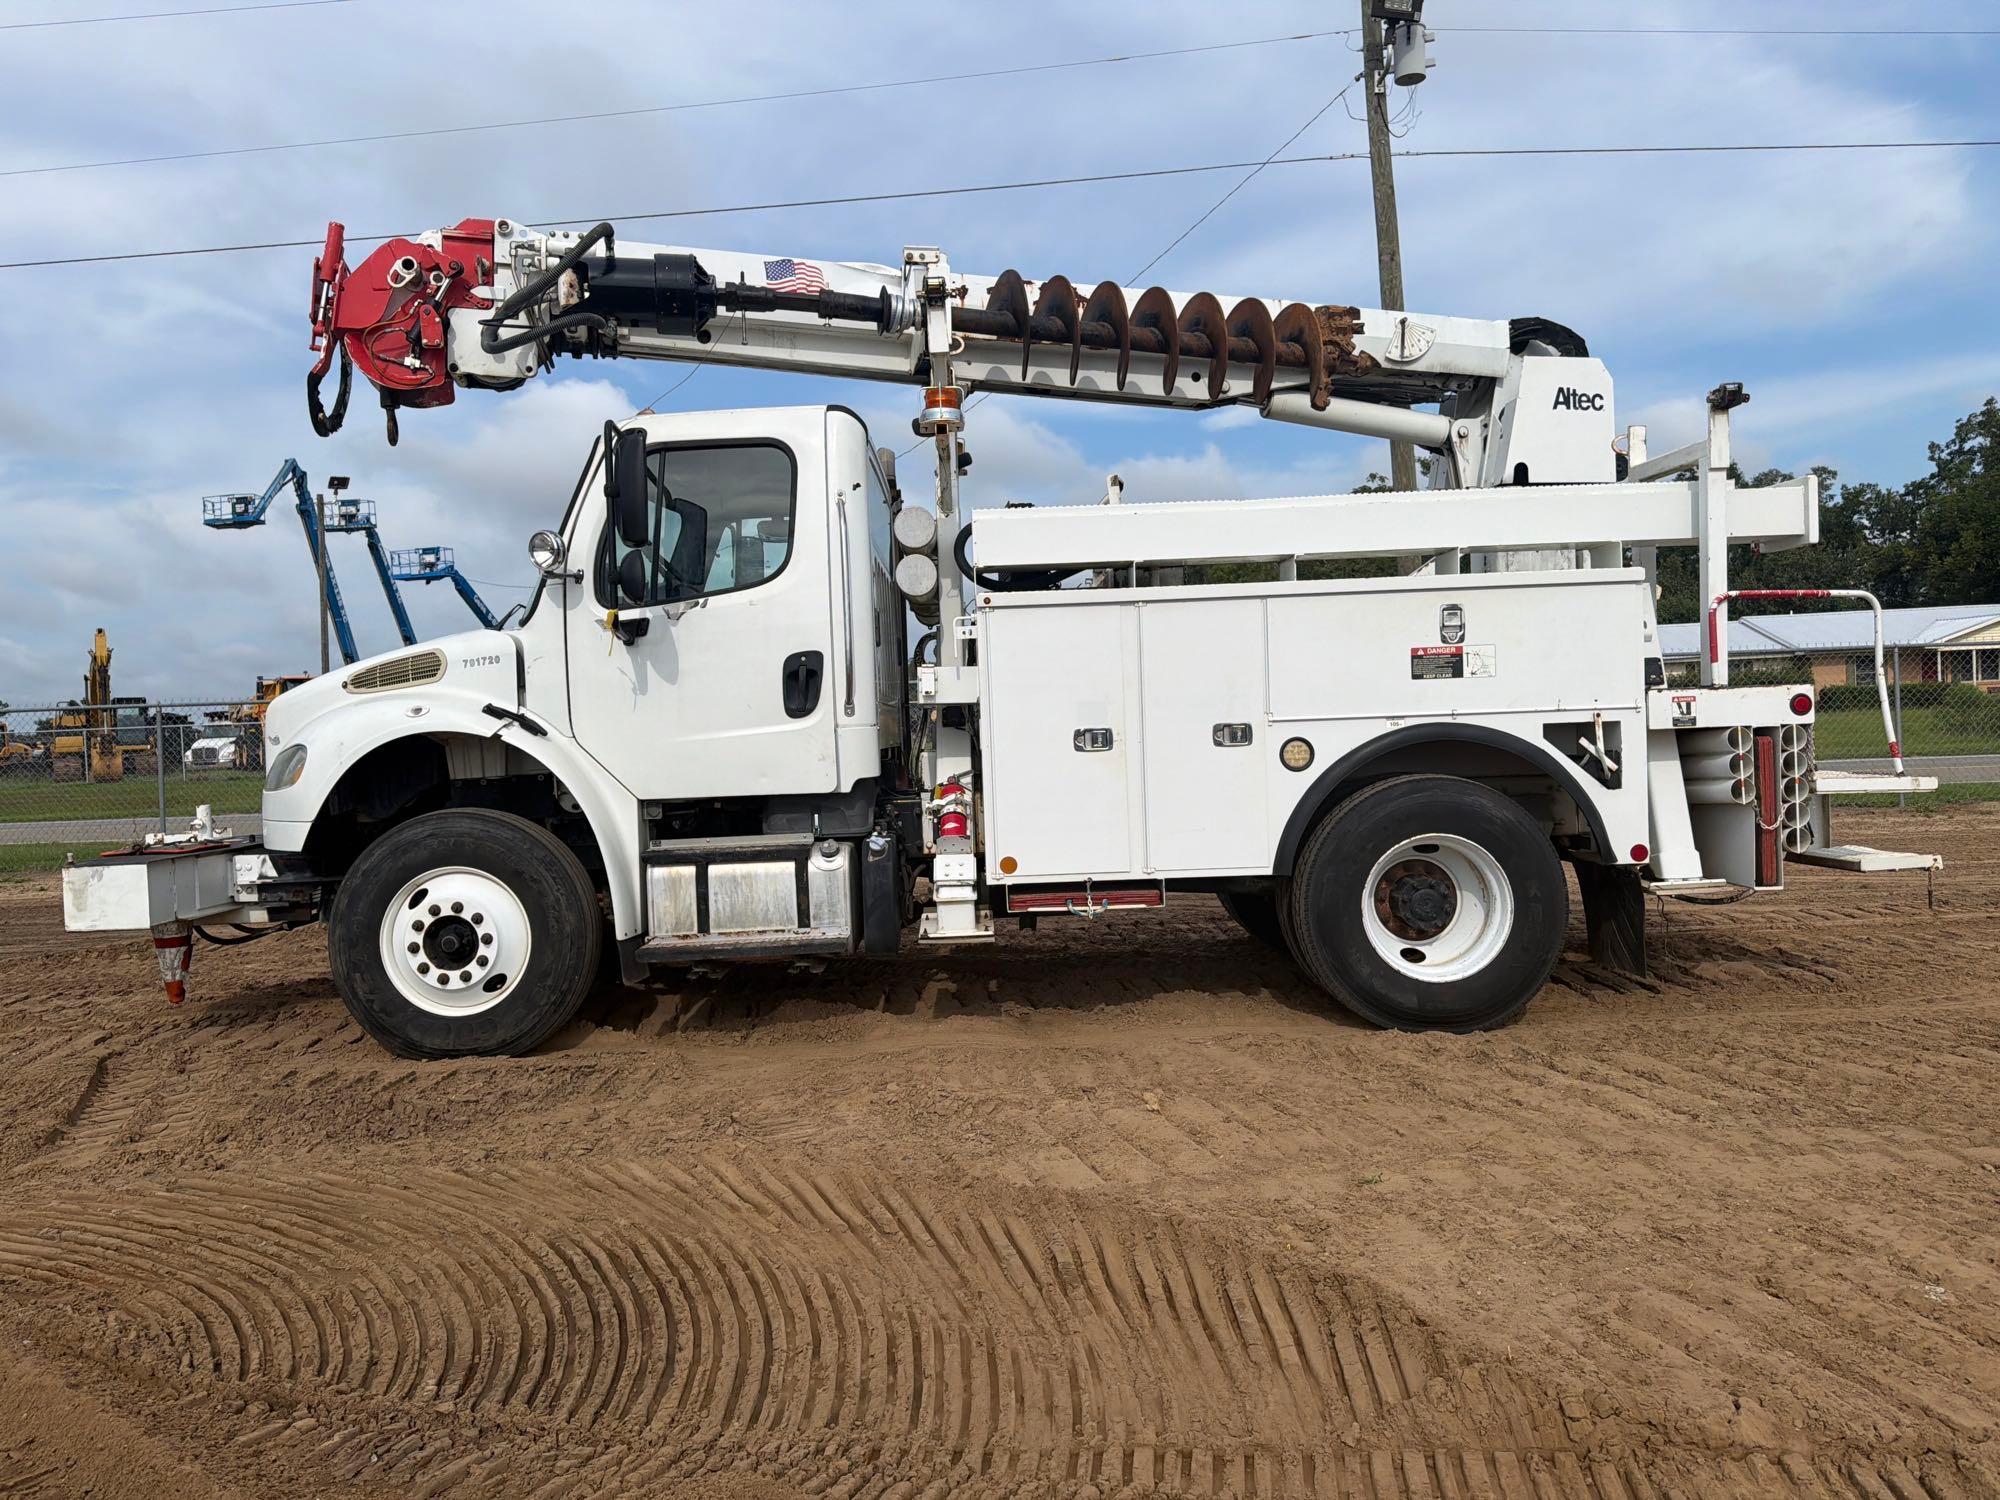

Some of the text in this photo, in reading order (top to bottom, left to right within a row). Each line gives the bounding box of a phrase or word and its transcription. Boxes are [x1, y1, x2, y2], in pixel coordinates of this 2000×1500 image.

[1552, 386, 1604, 411] Altec
[1427, 646, 1456, 654] DANGER
[462, 655, 501, 669] 701720
